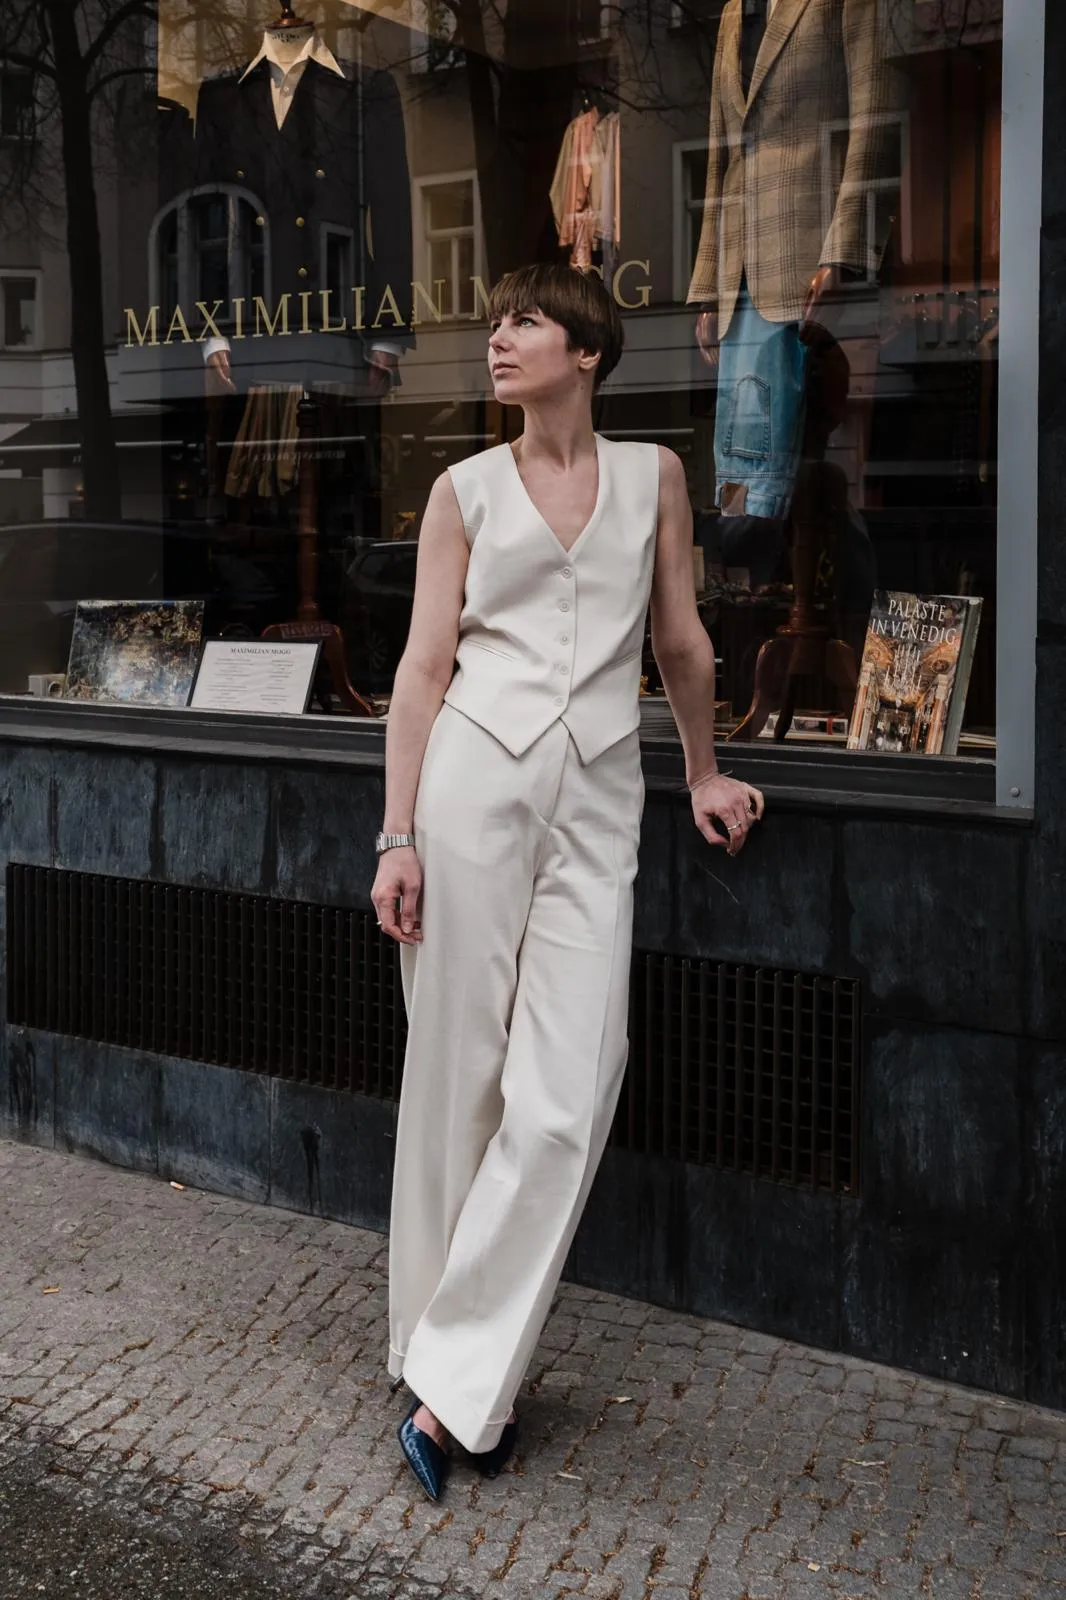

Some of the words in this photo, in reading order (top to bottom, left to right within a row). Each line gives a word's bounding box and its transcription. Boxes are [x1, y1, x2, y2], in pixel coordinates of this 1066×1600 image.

[123, 279, 446, 348] MAXIMILIAN
[870, 618, 888, 635] IN
[891, 620, 957, 646] VENEDIG
